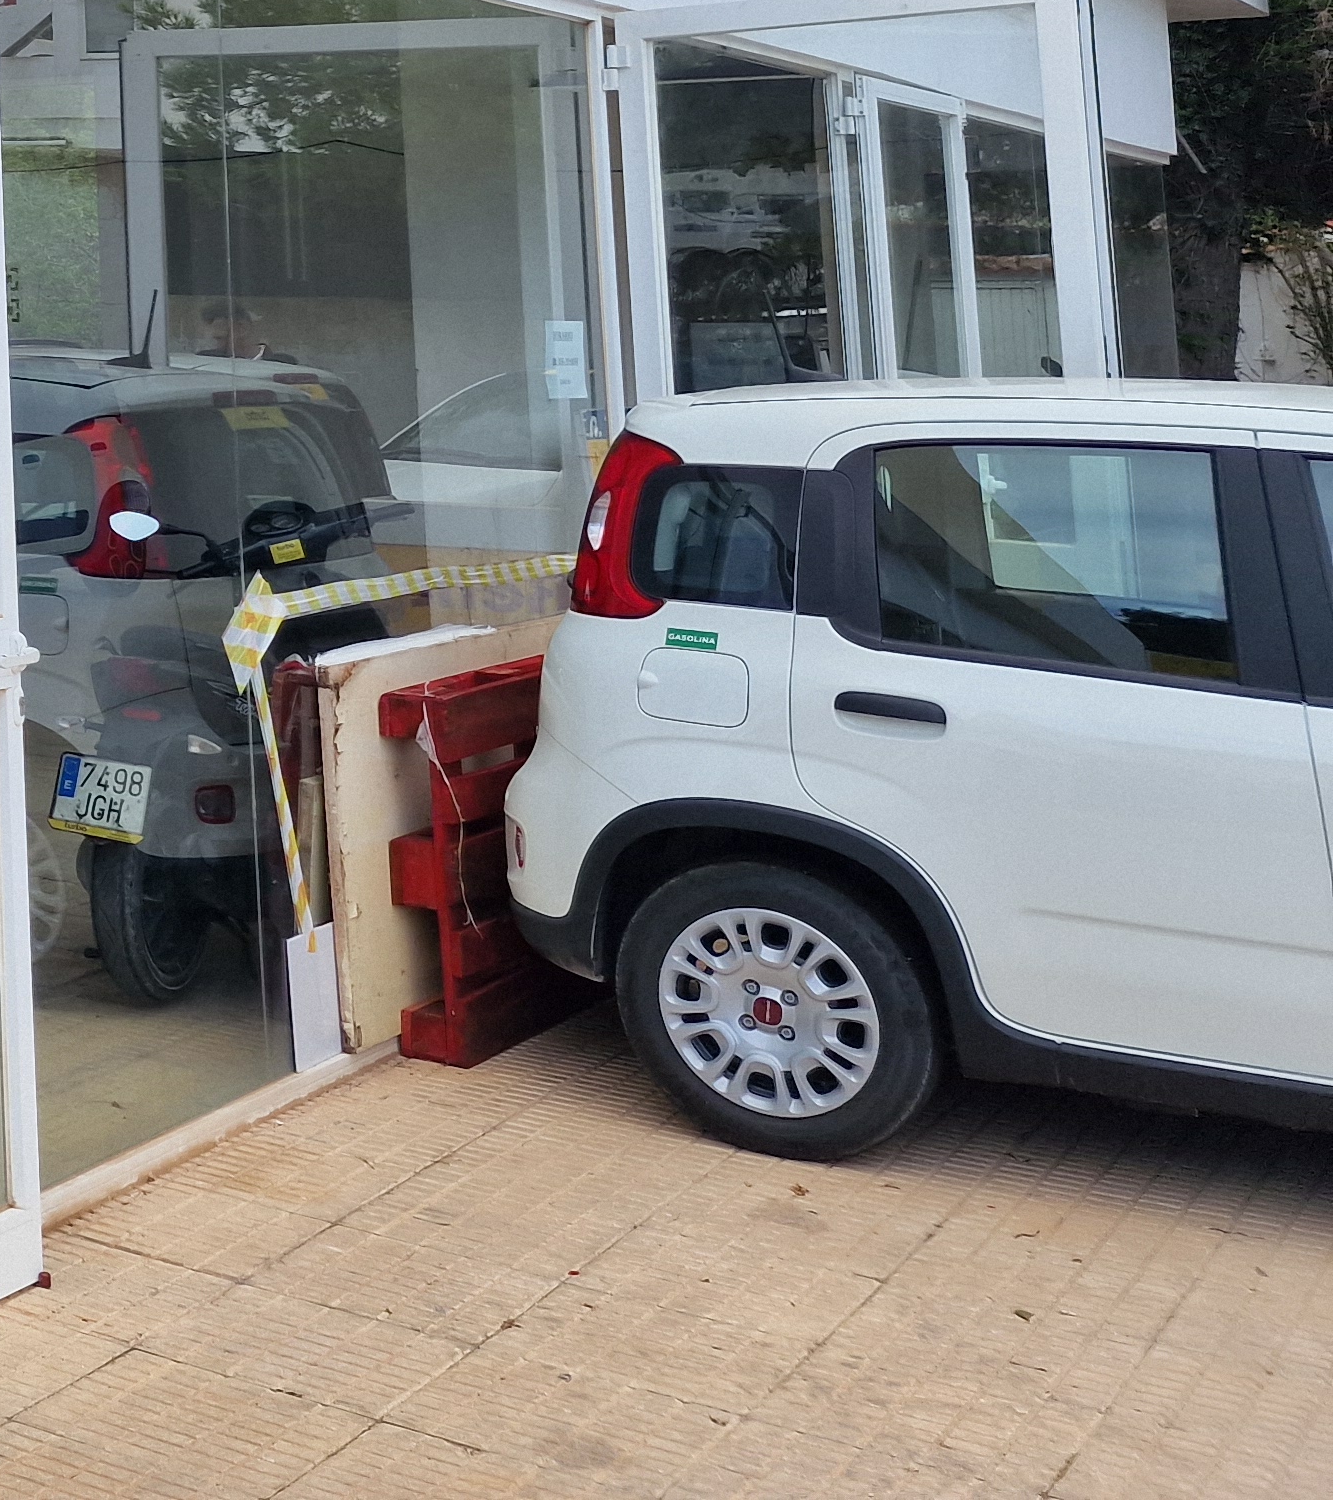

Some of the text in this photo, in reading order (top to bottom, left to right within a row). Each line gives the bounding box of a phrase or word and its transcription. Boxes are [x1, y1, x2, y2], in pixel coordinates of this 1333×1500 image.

[668, 633, 715, 644] GASOLINA
[63, 779, 73, 790] E
[80, 762, 144, 797] 7498
[75, 792, 124, 823] JGH
